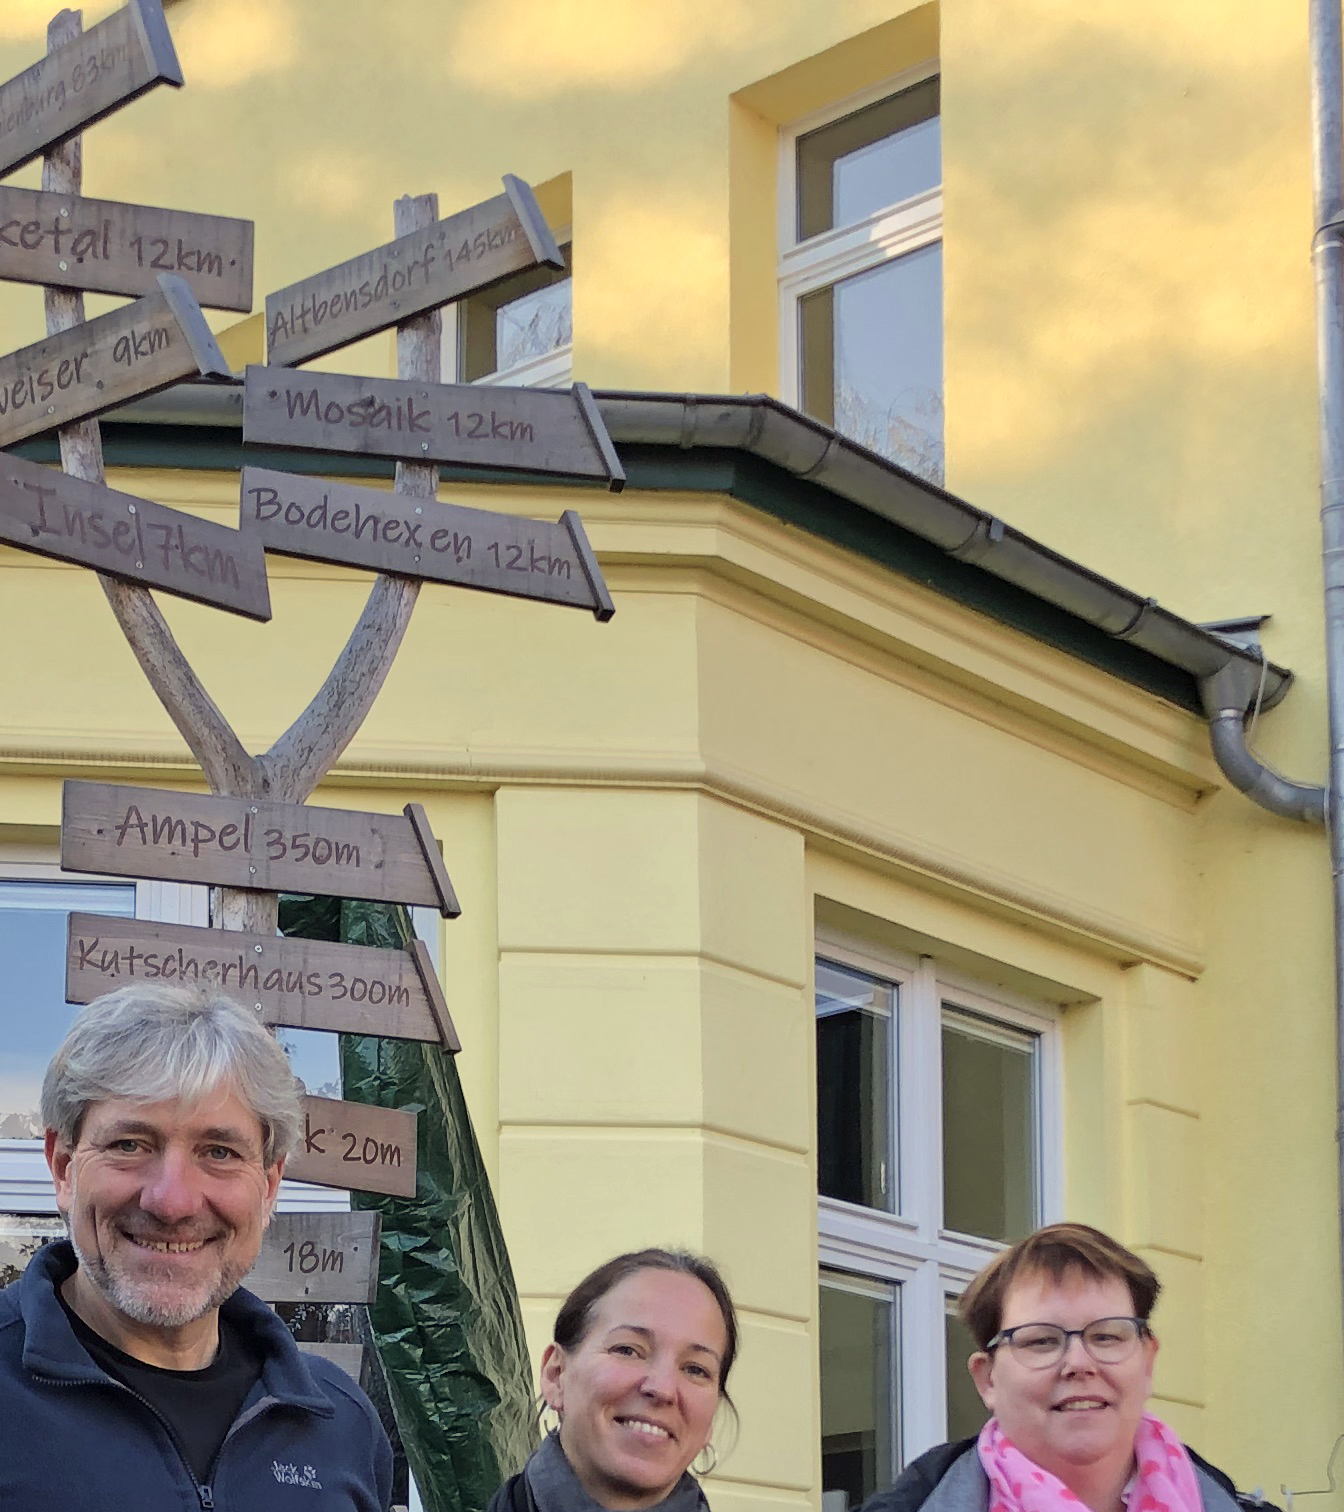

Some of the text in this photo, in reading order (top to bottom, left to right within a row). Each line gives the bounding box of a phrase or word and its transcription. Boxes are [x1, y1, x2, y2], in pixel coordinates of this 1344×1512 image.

[129, 236, 223, 277] 12km
[269, 243, 436, 347] Altbensdorf
[113, 326, 171, 367] 9km
[286, 388, 535, 444] Mosaik 12km
[23, 481, 146, 561] Insel
[248, 486, 571, 579] Bodehexen 12km
[115, 804, 361, 868] Ampel 350m
[78, 937, 410, 1008] Kutscherhaus 300m
[342, 1132, 401, 1168] 20m
[284, 1242, 344, 1274] 18m
